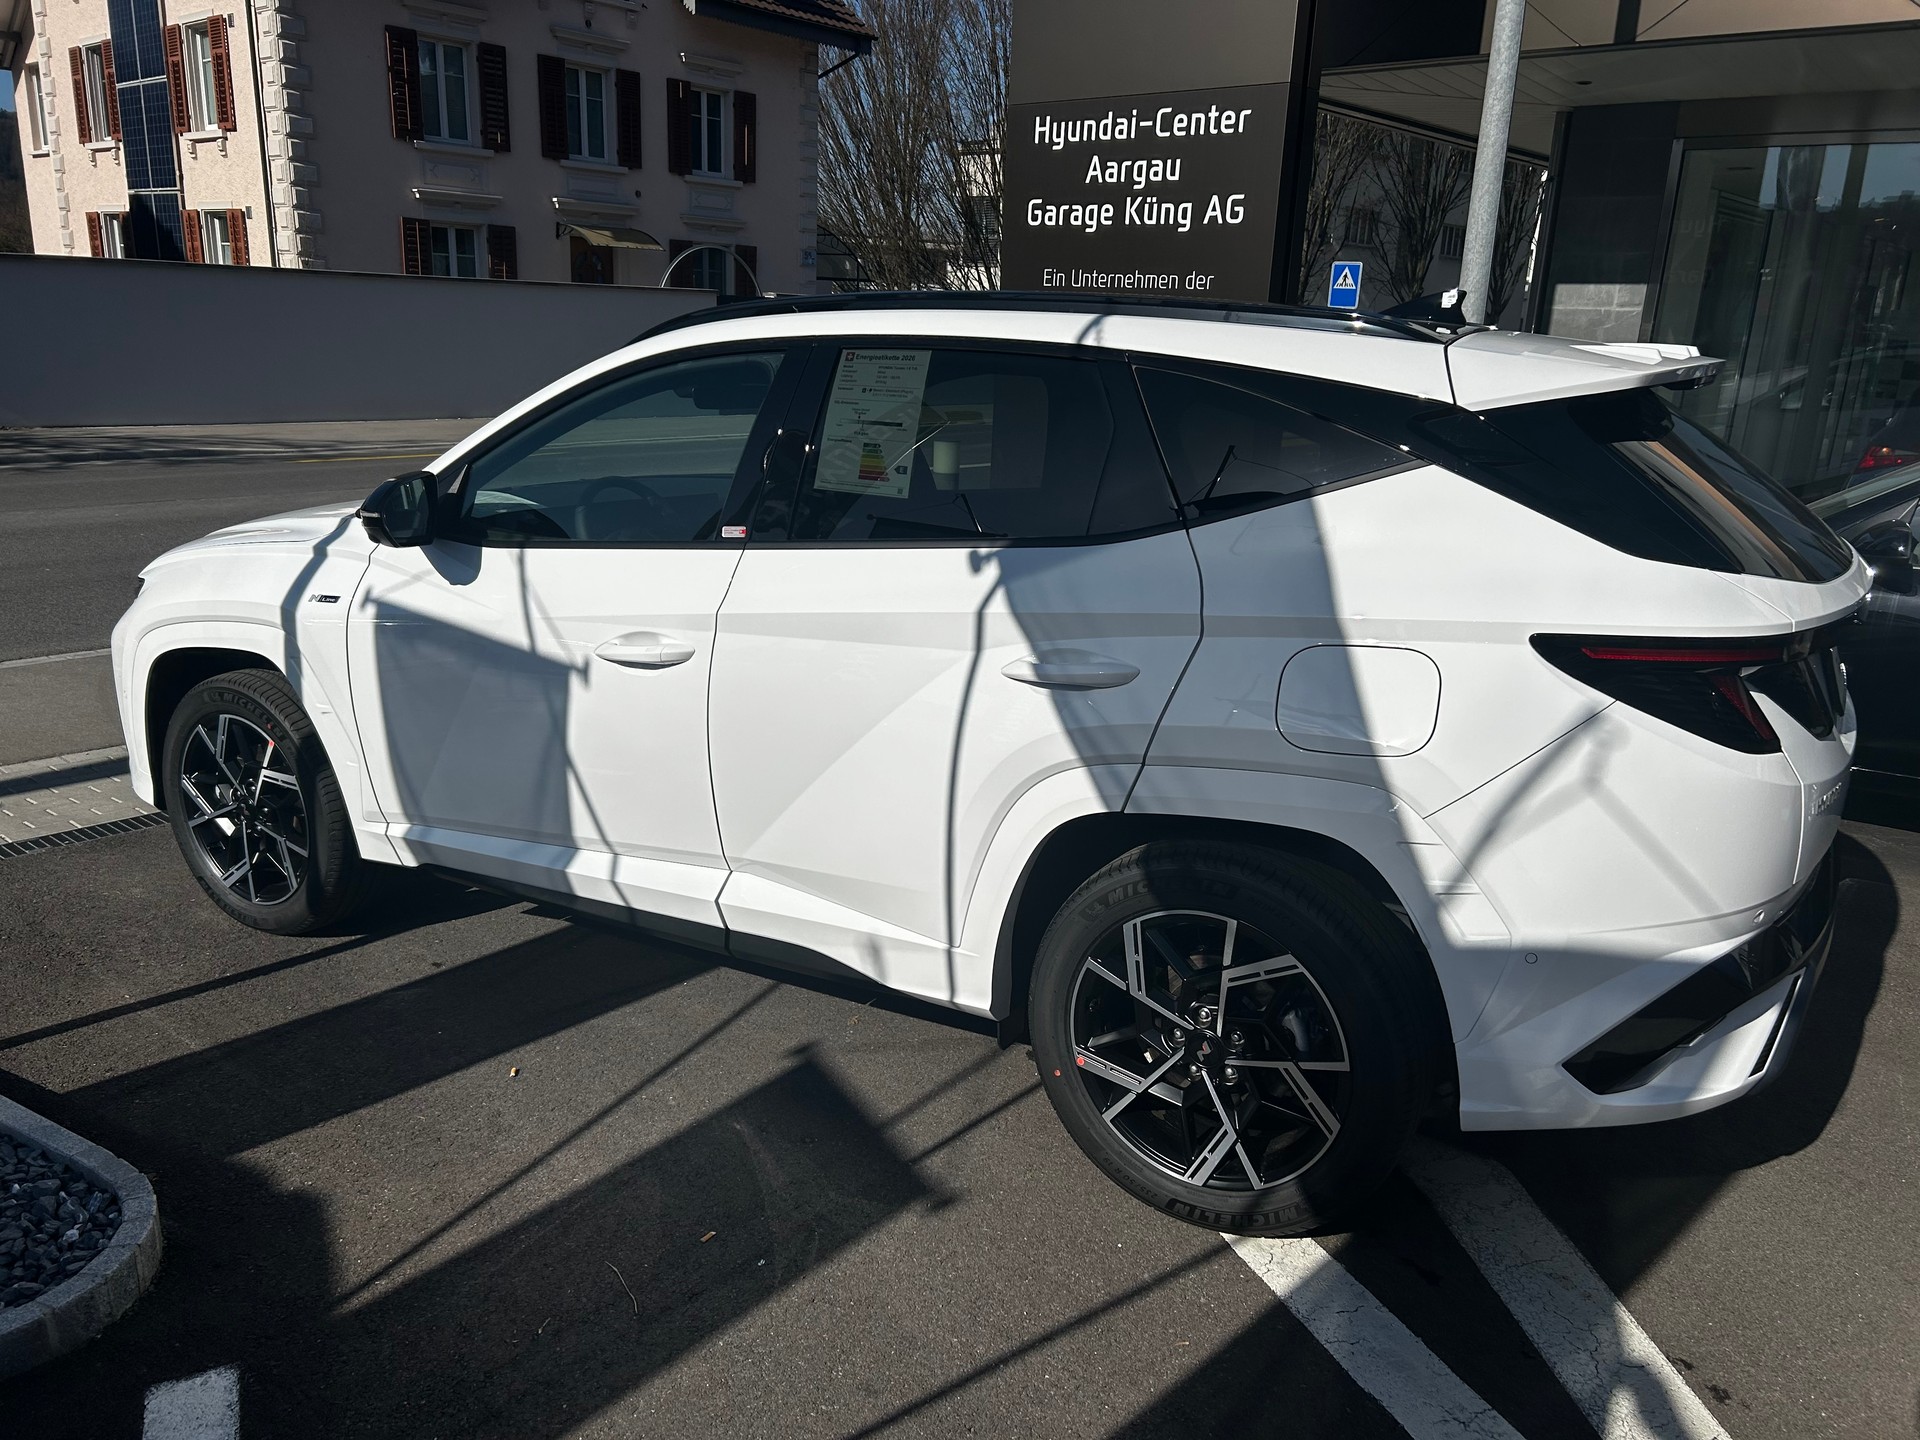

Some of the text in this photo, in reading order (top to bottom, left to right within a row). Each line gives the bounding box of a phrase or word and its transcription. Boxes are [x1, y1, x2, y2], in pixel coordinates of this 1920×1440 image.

[1034, 104, 1253, 150] Hyundai-Center
[1084, 154, 1182, 190] Aargau
[1027, 193, 1246, 233] Garage Küng AG
[1043, 268, 1215, 290] Ein Unternehmen der
[1172, 1202, 1298, 1229] MICHELIN
